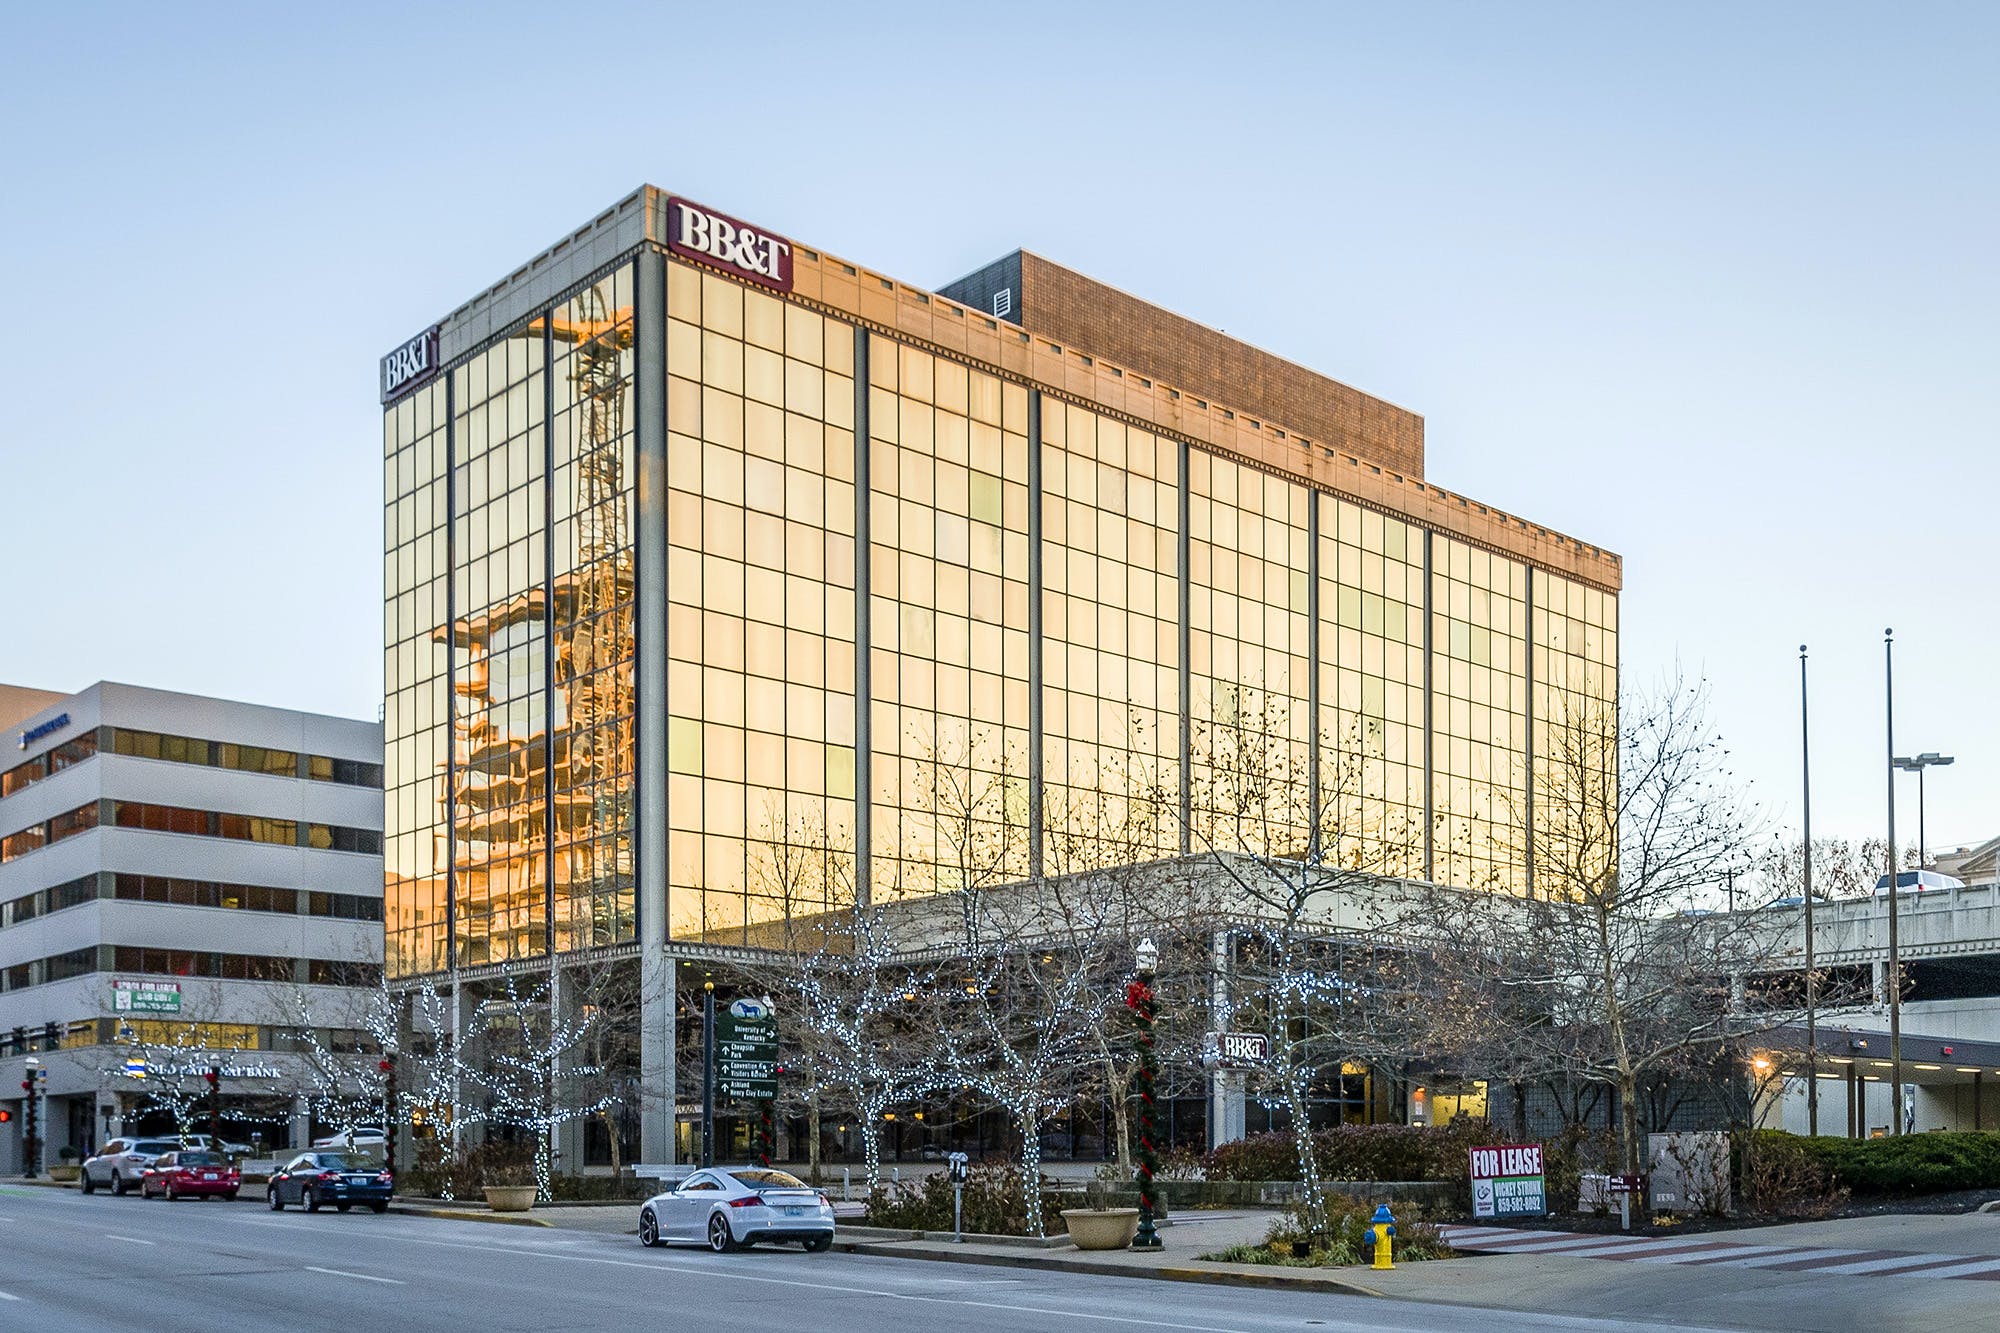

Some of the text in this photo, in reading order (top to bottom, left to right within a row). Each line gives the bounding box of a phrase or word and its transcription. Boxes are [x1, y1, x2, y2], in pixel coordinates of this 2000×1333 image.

[677, 202, 789, 282] BB&T
[385, 331, 432, 394] BB&T
[141, 982, 156, 991] FOR
[734, 1025, 759, 1034] University
[743, 1034, 766, 1043] Kentucky
[731, 1043, 755, 1052] Cheapside
[1225, 1036, 1264, 1060] BB&T
[731, 1051, 742, 1059] Park
[730, 1061, 757, 1070] Convention
[246, 1066, 281, 1079] BANK
[730, 1070, 750, 1078] Visitors
[730, 1089, 745, 1097] Henry
[745, 1089, 756, 1098] Clay
[1472, 1147, 1541, 1177] FOR LEASE
[1494, 1182, 1517, 1197] VICKEY
